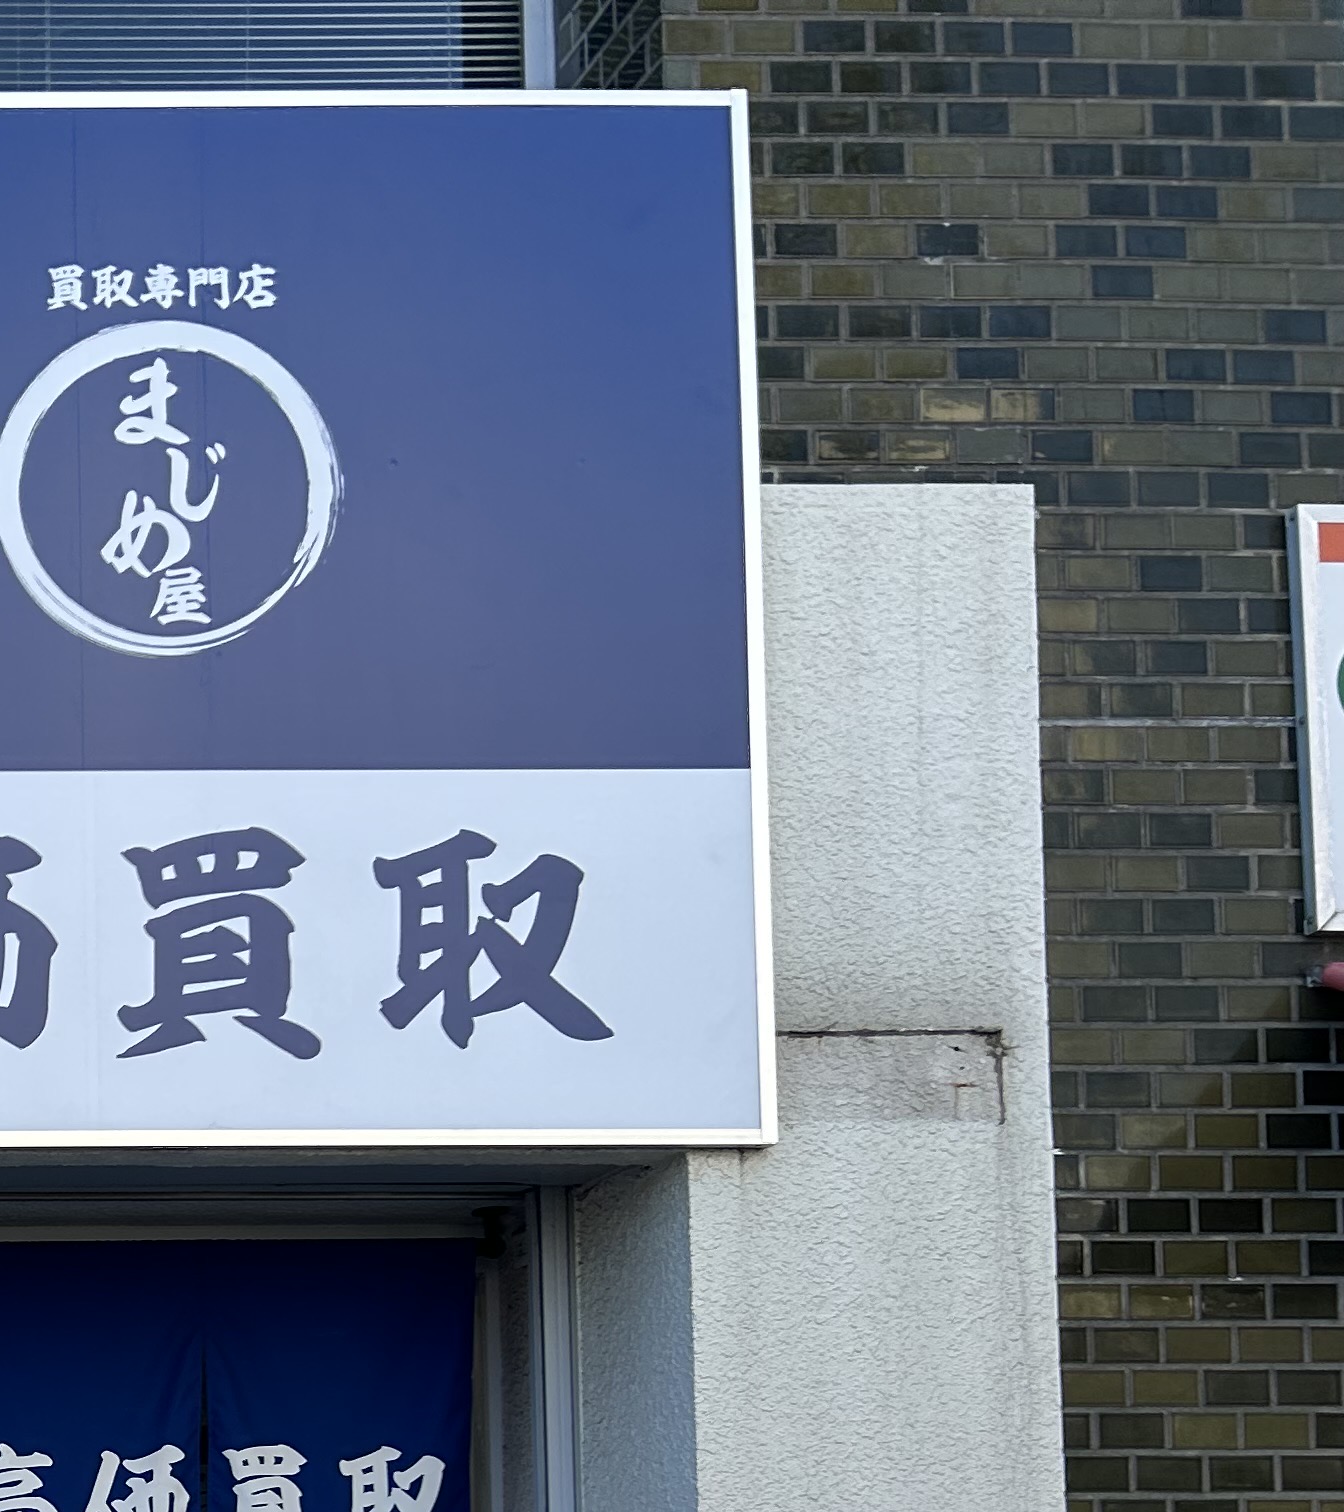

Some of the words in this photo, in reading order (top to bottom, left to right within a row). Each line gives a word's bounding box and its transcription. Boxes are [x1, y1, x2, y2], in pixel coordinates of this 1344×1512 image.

[47, 263, 278, 311] 買取専門店
[100, 357, 227, 625] まじめ屋
